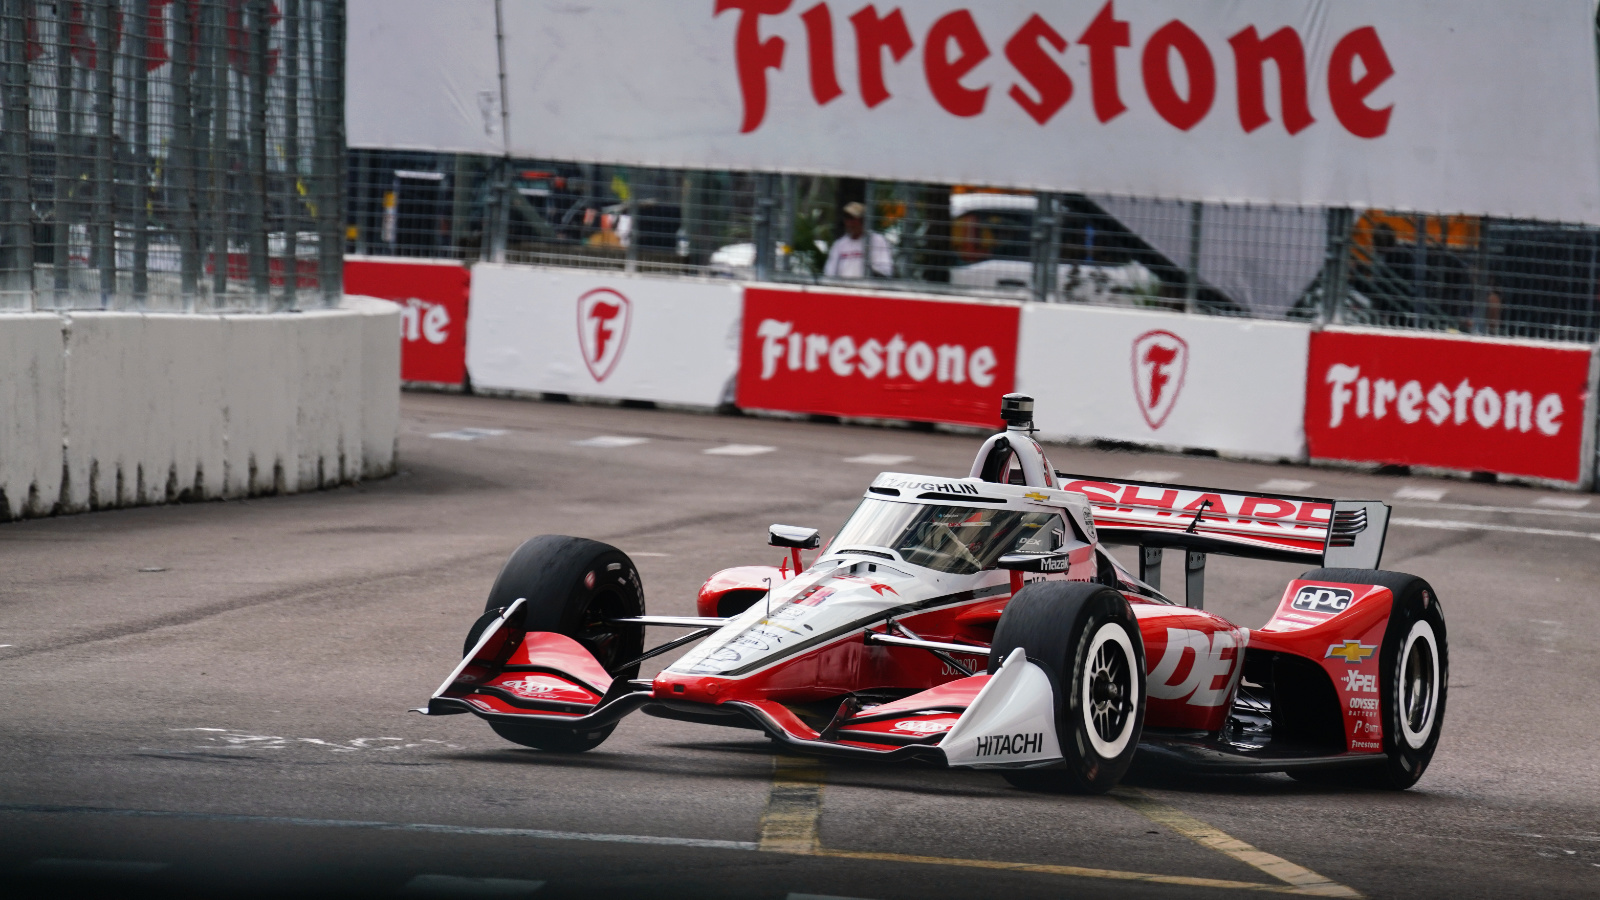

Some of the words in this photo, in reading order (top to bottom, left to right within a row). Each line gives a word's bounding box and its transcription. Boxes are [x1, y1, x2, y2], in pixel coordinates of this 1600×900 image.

[714, 0, 1395, 139] Firestone
[757, 318, 997, 388] Firestone
[1325, 363, 1564, 437] Firestone
[1019, 537, 1042, 546] DEX
[1041, 556, 1069, 571] Mazak
[1296, 590, 1349, 610] PPG
[1345, 669, 1378, 693] XPEL
[1349, 697, 1380, 710] ODYSSEY
[1348, 710, 1378, 718] BATTERY
[975, 732, 1043, 757] HITACHI
[1351, 739, 1380, 749] Firestone
